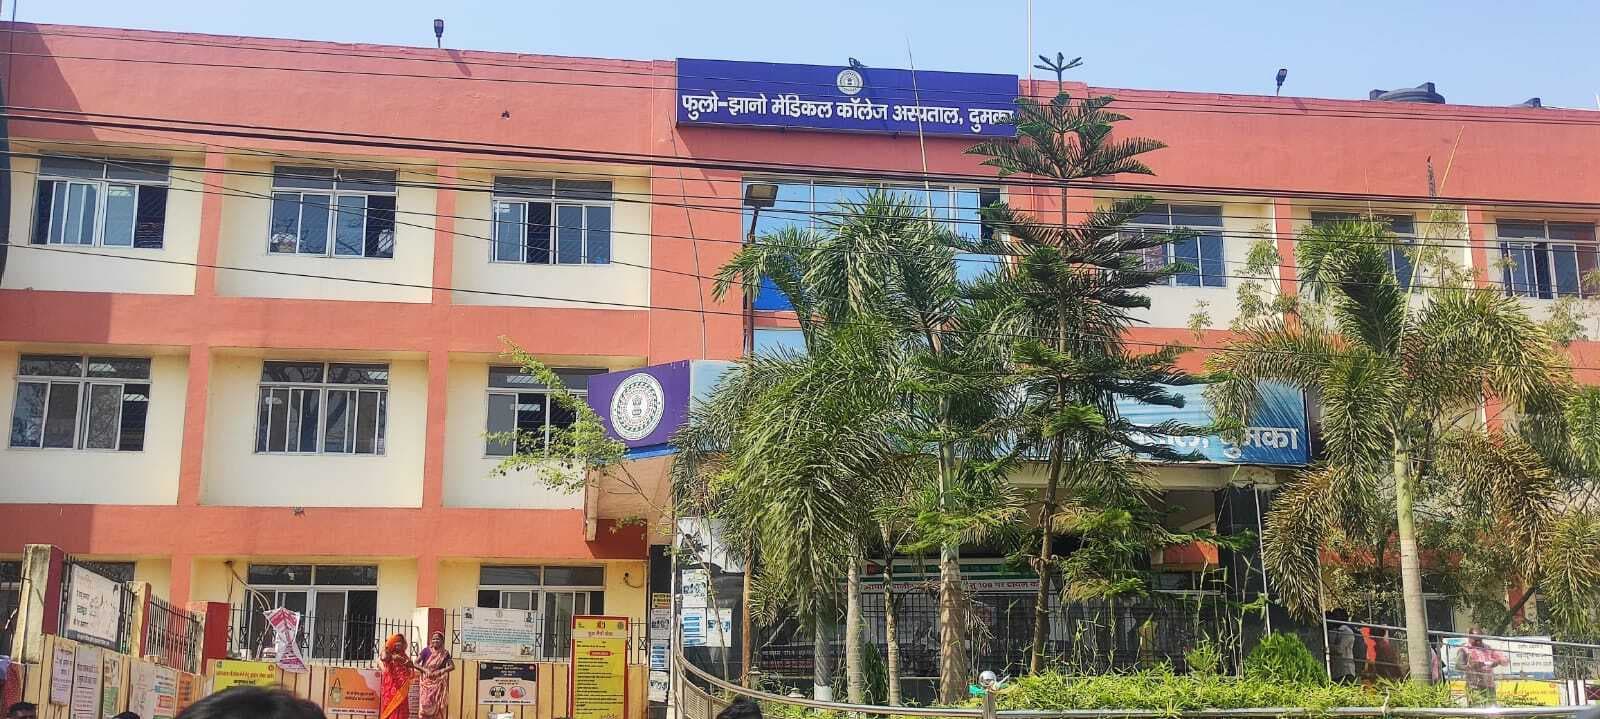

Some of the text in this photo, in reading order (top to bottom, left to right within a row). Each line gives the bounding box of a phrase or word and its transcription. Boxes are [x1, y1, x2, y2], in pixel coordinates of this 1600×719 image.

[681, 90, 1014, 133] फुलो-झानो मेडिकल कॉलेज अस्पताल, दुमका
